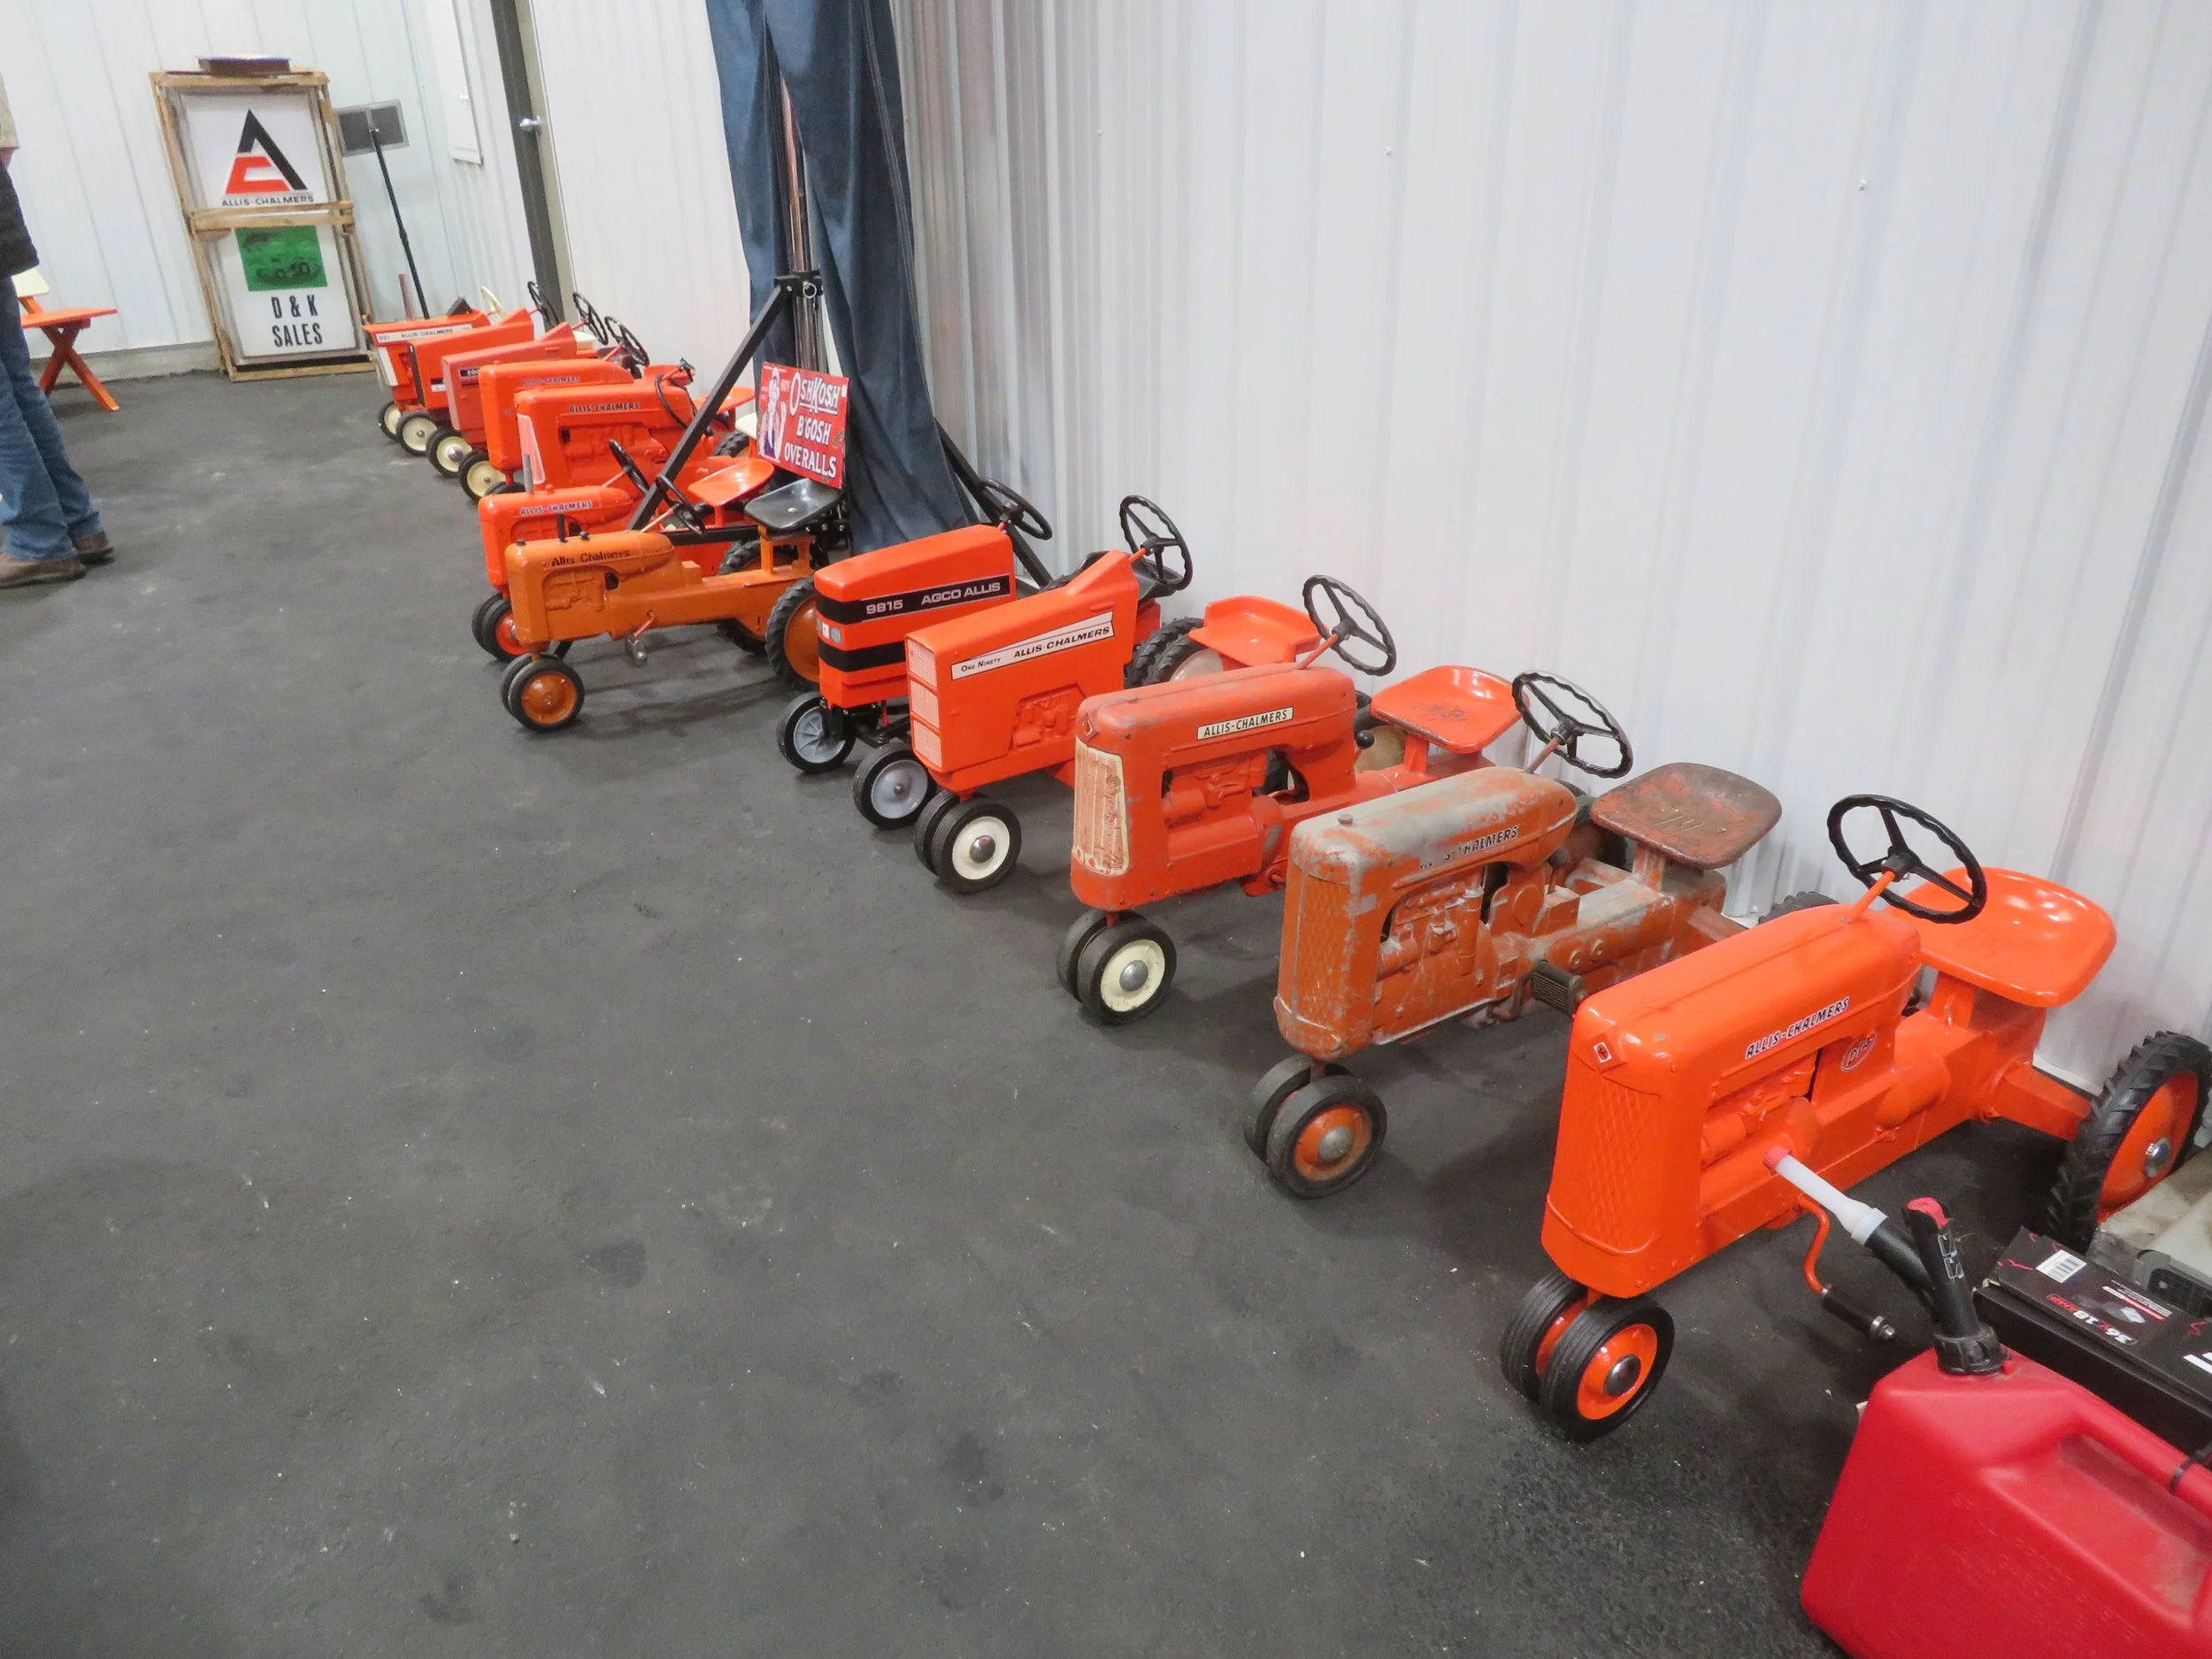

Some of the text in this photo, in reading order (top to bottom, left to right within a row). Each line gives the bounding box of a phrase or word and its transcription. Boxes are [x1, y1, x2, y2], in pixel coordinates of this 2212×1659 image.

[221, 195, 315, 207] ALLIS-CHALMERS
[271, 293, 319, 319] D & K
[272, 322, 323, 348] SALES
[569, 402, 641, 414] ALLIS-CHALMERS
[790, 372, 841, 417] OSHKOSH
[796, 415, 832, 446] B'GOSH
[784, 442, 837, 479] OVERALLS
[551, 549, 631, 567] Allis Chalmers
[866, 582, 1001, 615] 9815 AGCO ALLIS
[1203, 710, 1287, 737] ALLIS-CHALMERS
[1746, 997, 1849, 1059] ALLIS-CHALMERS
